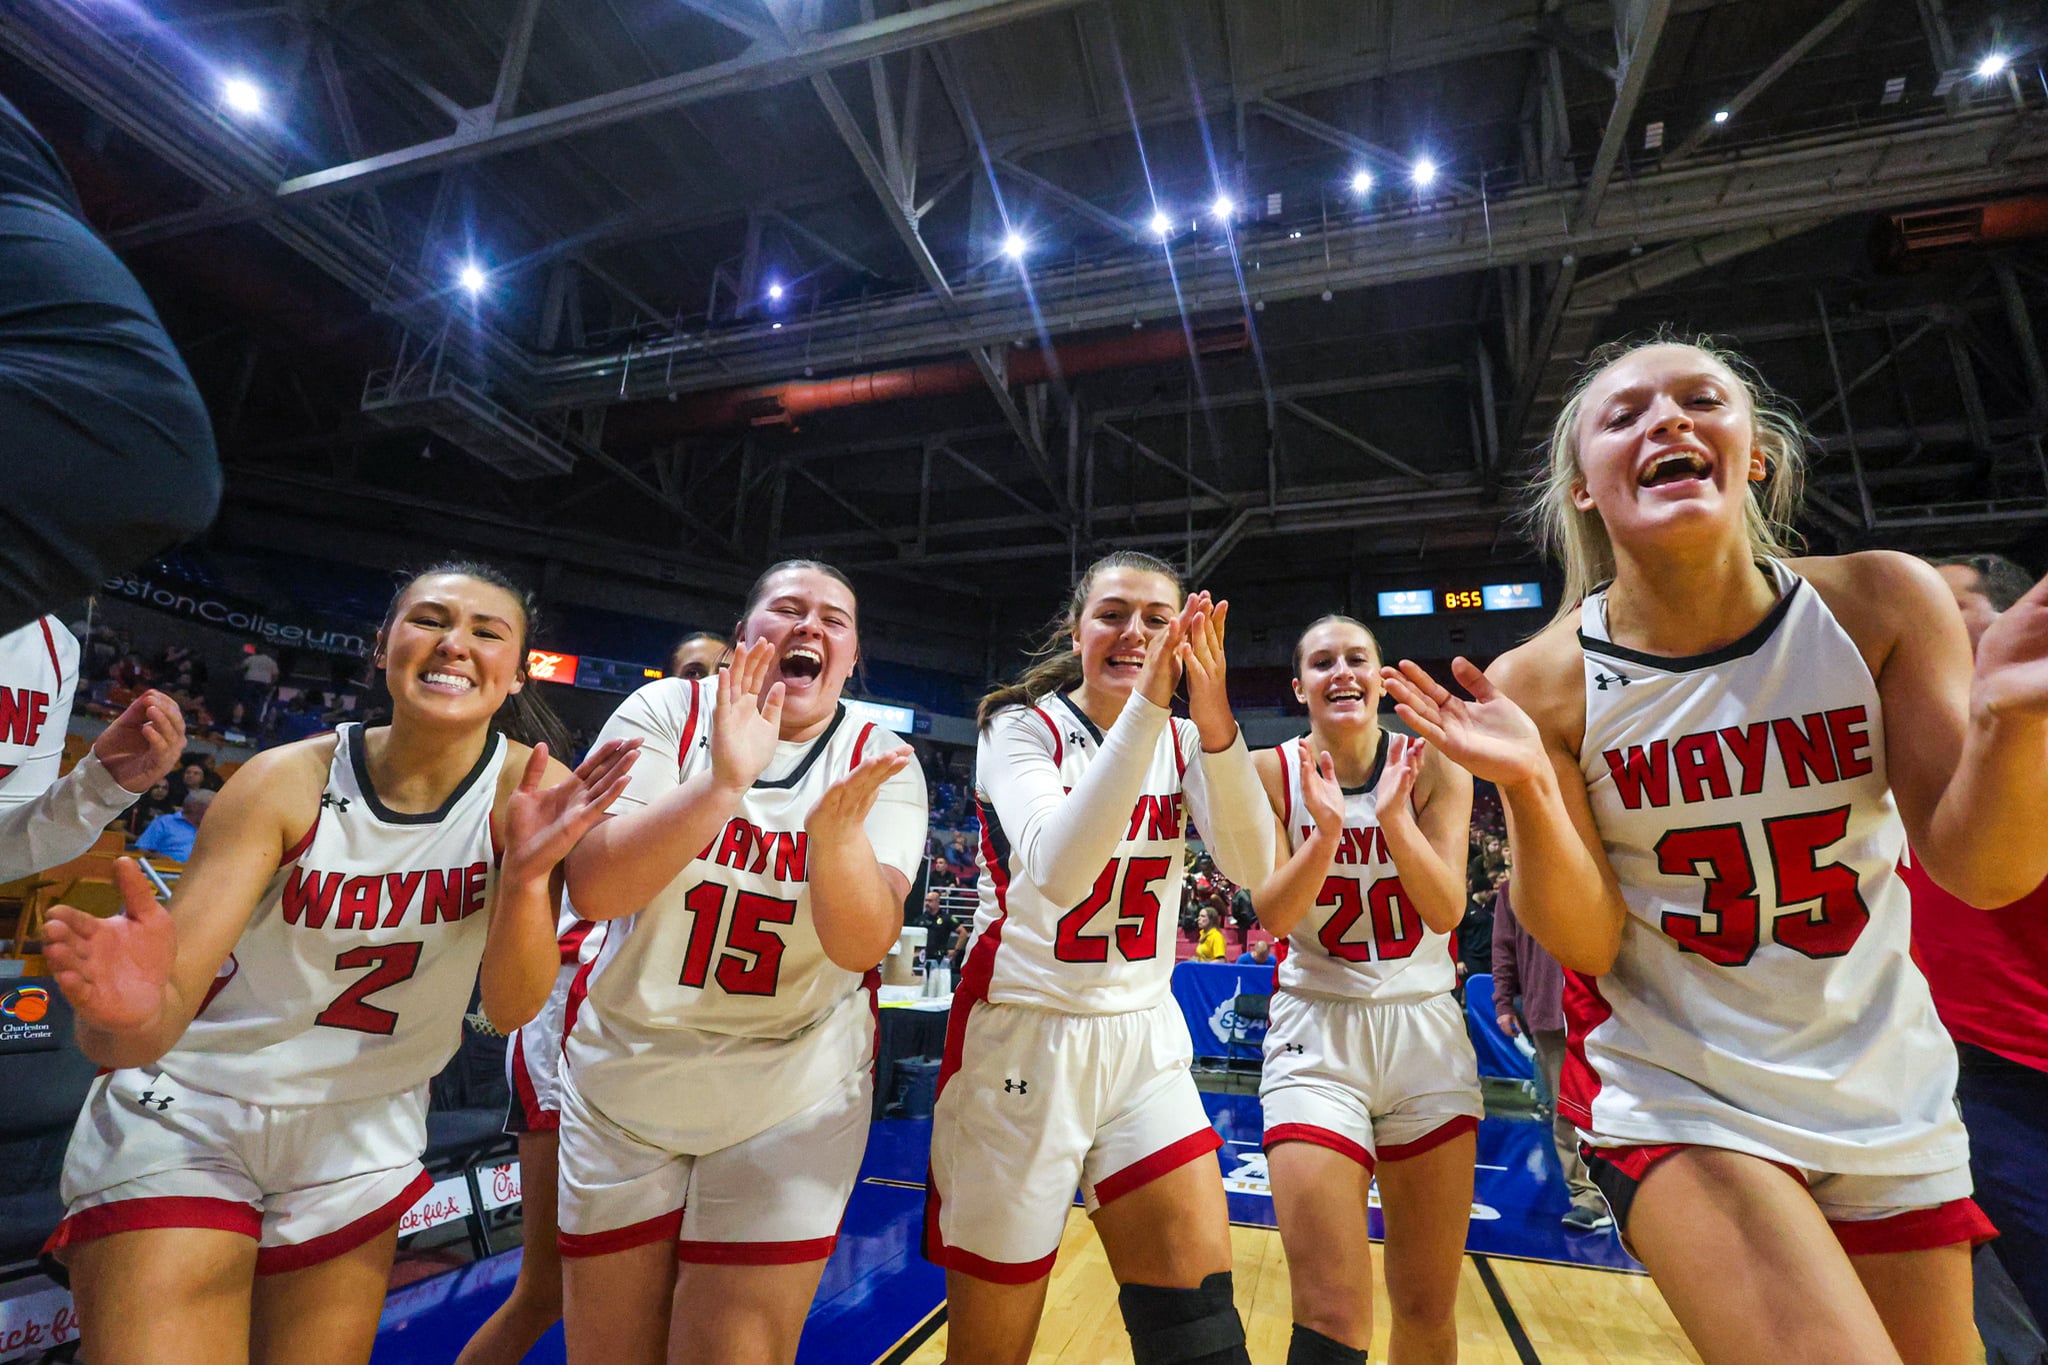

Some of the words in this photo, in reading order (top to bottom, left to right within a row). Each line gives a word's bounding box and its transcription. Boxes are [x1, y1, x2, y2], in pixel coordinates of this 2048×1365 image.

[1445, 591, 1482, 608] 8:55
[1602, 705, 1873, 809] WAYNE
[696, 816, 810, 882] AYN
[1653, 804, 1871, 967] 35
[282, 861, 487, 930] WAYNE
[678, 879, 798, 997] 15
[1054, 856, 1172, 963] 25
[1315, 875, 1424, 962] 20
[3, 1023, 49, 1032] Charleston
[313, 941, 424, 1036] 2
[0, 1032, 21, 1041] Civic
[23, 1031, 53, 1039] Center
